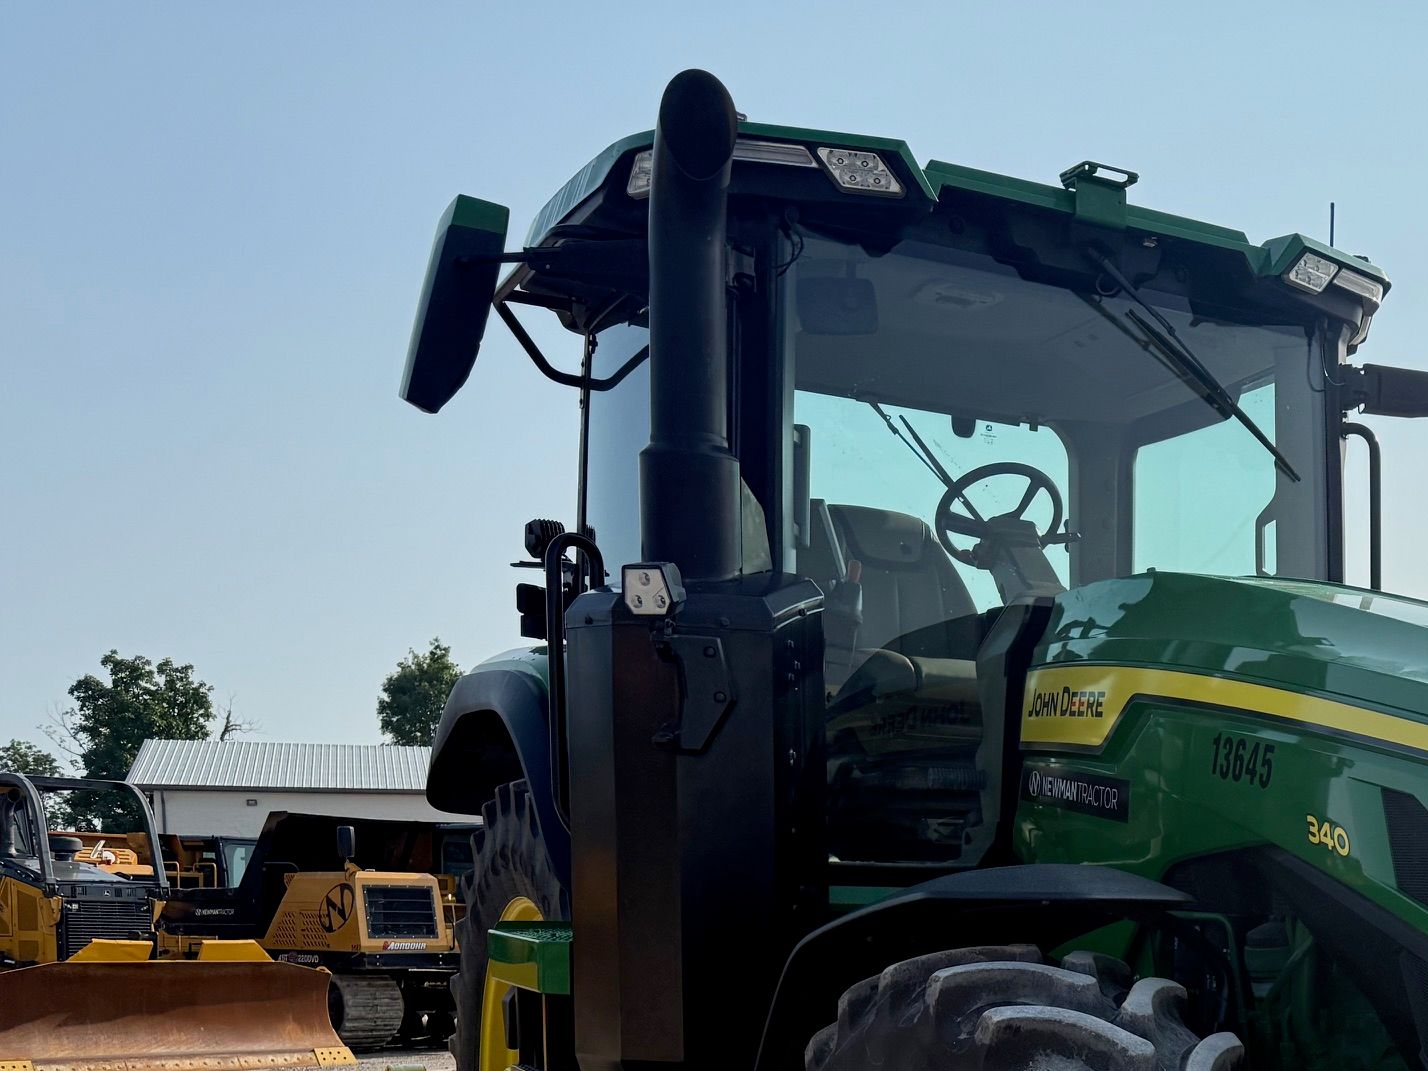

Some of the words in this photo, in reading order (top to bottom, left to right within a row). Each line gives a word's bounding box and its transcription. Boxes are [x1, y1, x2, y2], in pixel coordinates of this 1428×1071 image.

[1028, 688, 1059, 718] JOHN
[1060, 686, 1106, 718] DEERE
[1211, 731, 1276, 790] 13645
[1306, 813, 1351, 857] 340
